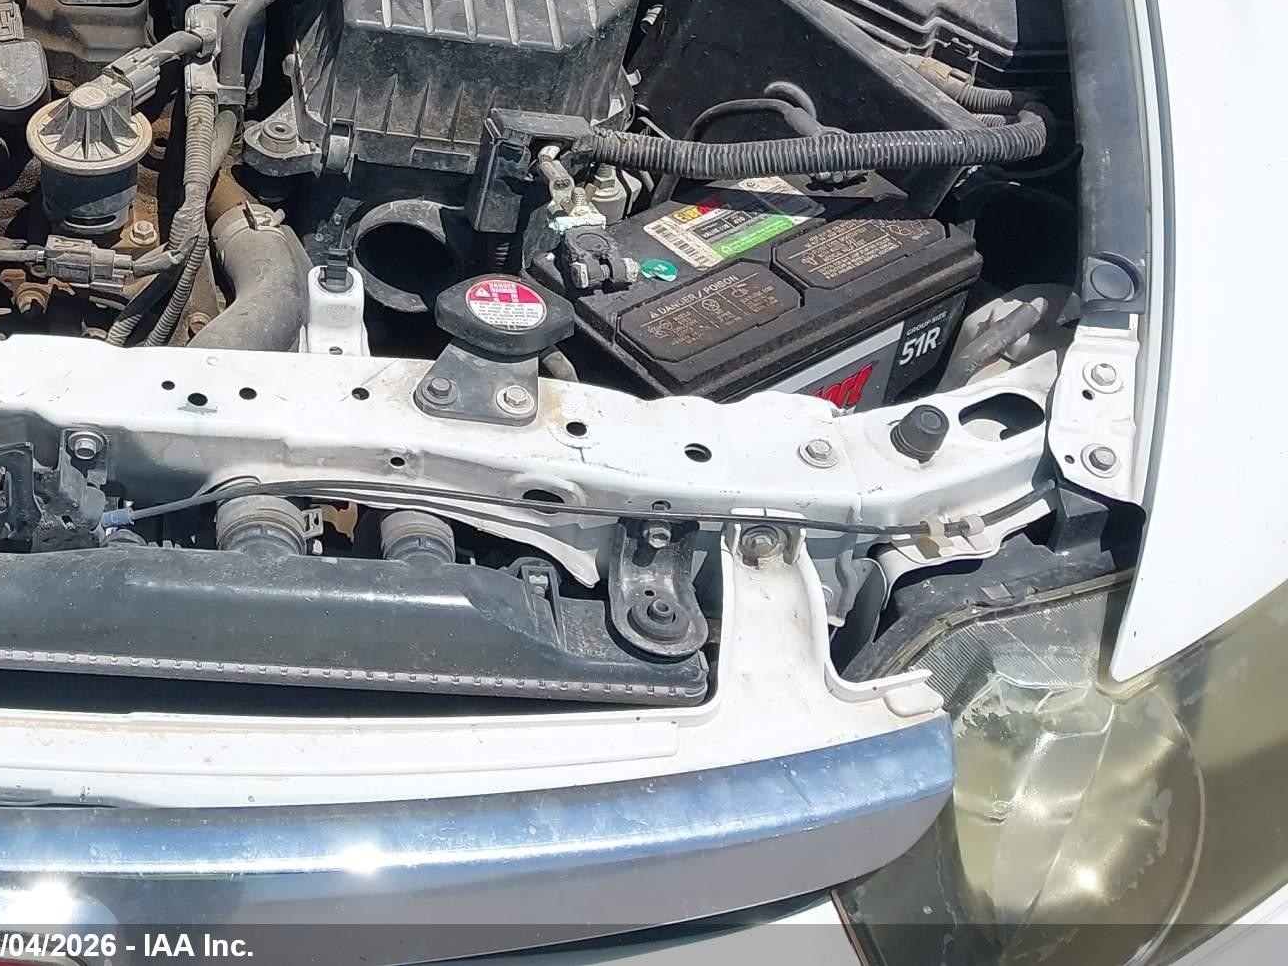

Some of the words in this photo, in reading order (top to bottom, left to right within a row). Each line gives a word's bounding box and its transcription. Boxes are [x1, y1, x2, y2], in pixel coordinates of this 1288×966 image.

[703, 275, 739, 294] POISON
[906, 319, 932, 336] GROUP
[931, 310, 948, 324] SIZE
[899, 326, 941, 366] 51R
